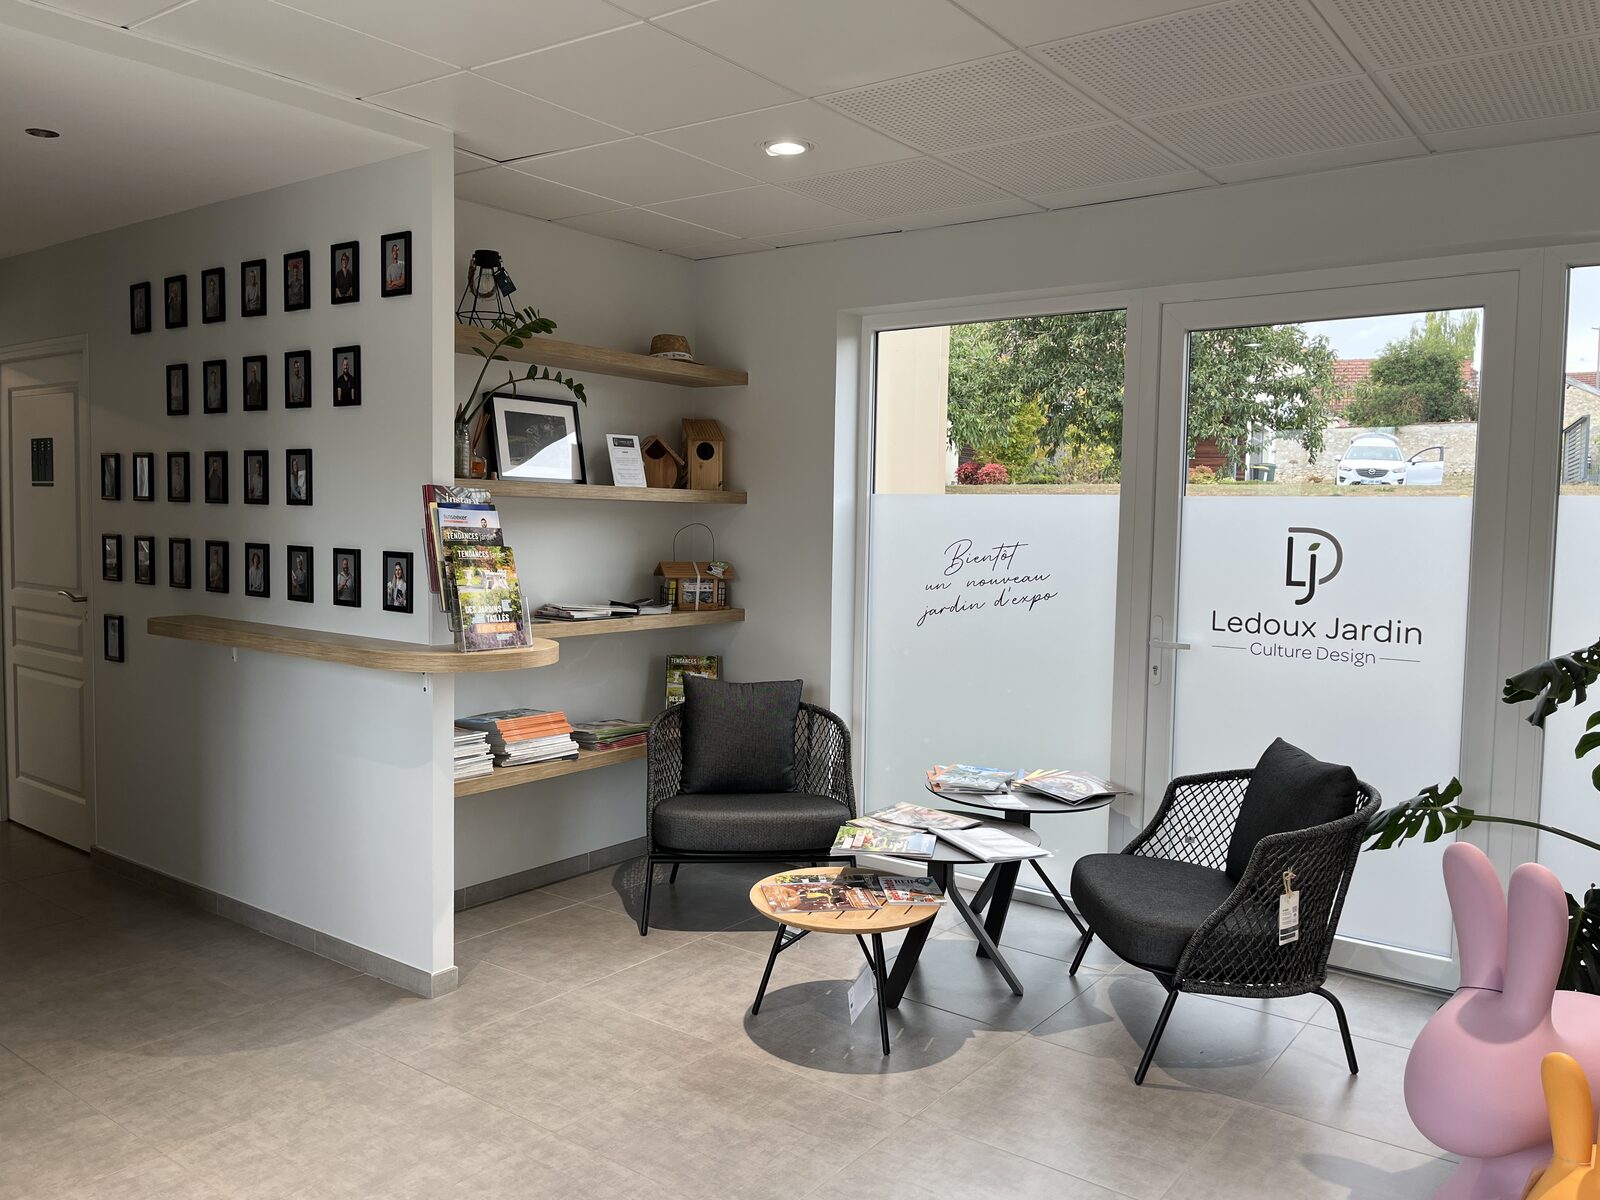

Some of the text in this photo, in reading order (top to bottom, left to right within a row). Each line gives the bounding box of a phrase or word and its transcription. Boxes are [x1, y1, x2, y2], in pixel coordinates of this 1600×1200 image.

[447, 532, 479, 540] TENDANCES
[944, 539, 1029, 576] Bientôt
[925, 573, 1051, 591] un nouveau
[465, 606, 478, 614] DES
[916, 587, 1058, 627] jardin d'expo
[1212, 610, 1423, 645] Ledoux Jardin
[1249, 642, 1377, 668] Culture Design
